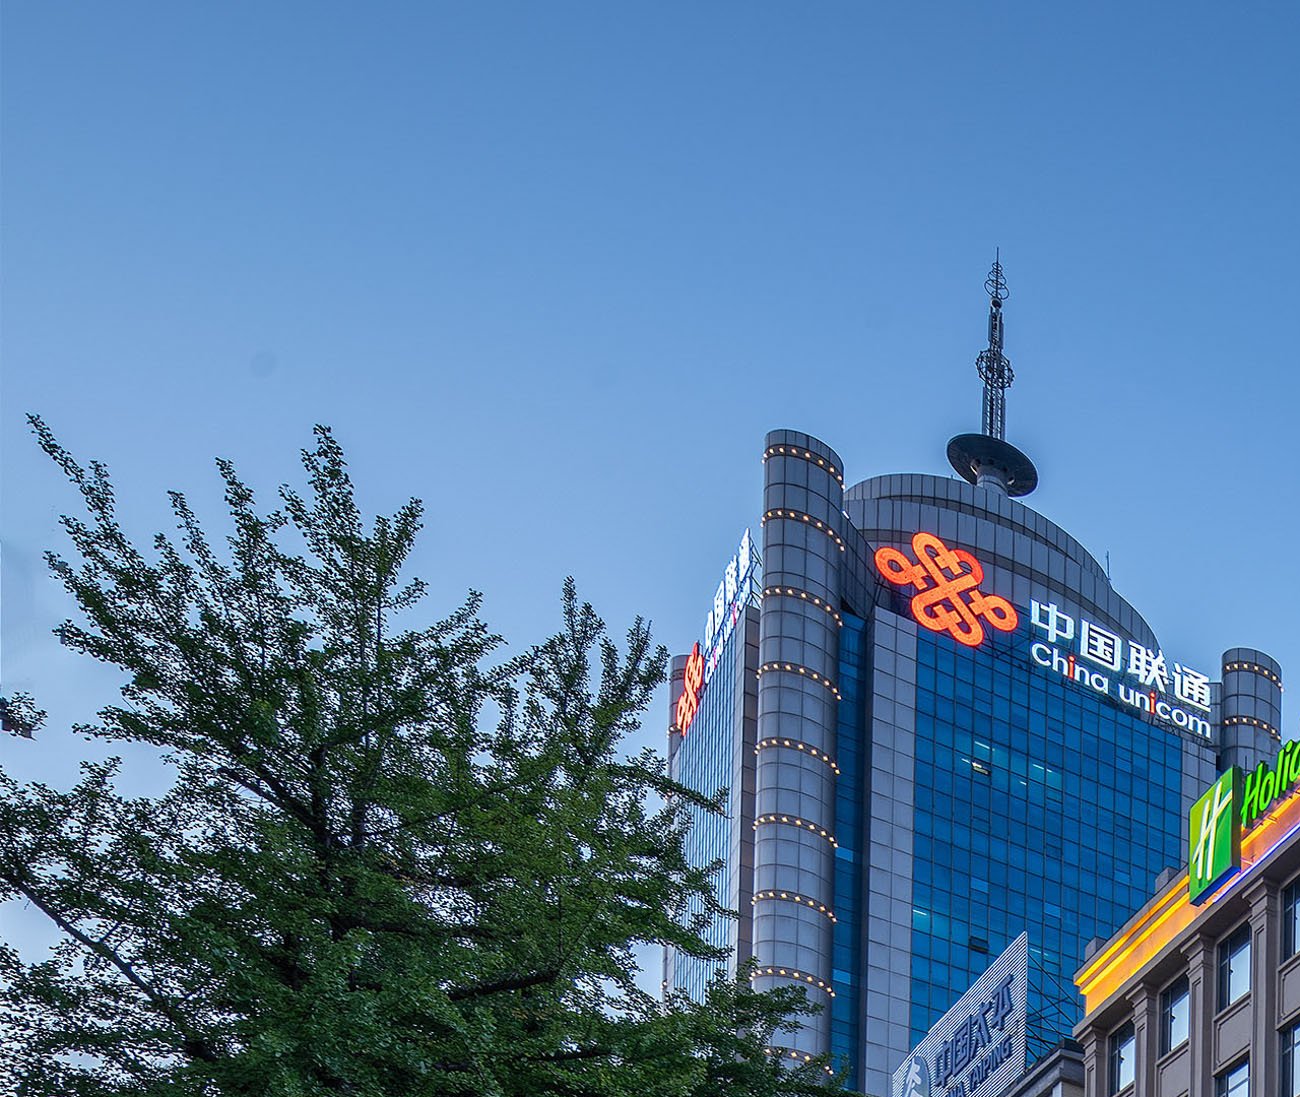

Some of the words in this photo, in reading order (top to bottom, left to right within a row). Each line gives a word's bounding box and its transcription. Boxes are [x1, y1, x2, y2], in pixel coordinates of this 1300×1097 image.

[1030, 599, 1211, 713] 中国联通
[1031, 642, 1110, 694] China
[1119, 684, 1211, 738] unicom
[934, 974, 1014, 1088] 中国太平
[967, 1035, 1013, 1092] TAIPING
